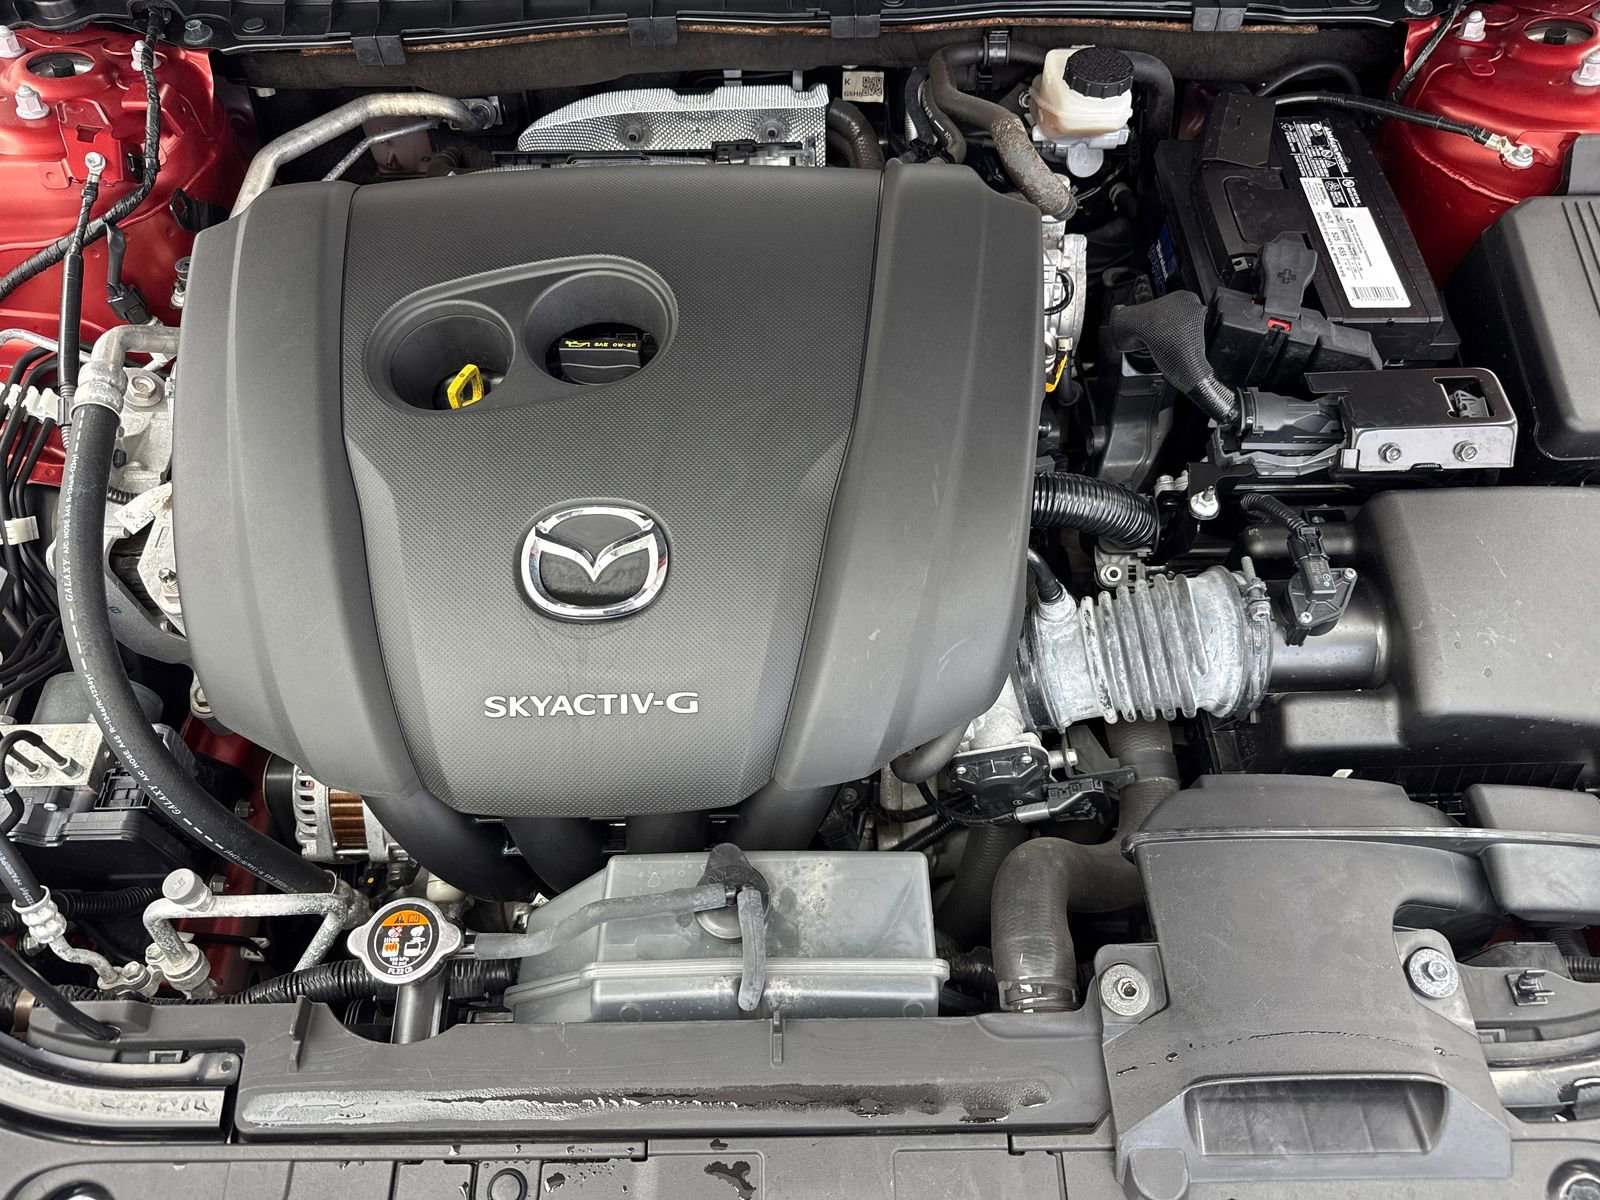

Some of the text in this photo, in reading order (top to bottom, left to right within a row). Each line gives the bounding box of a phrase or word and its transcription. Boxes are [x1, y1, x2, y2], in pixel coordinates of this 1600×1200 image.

[63, 519, 73, 538] HOSE
[63, 558, 74, 602] GALAXY
[484, 692, 699, 718] SKYACTIV-G
[122, 749, 140, 769] HOSE
[137, 769, 150, 782] A/C
[148, 784, 182, 816] GALAXY
